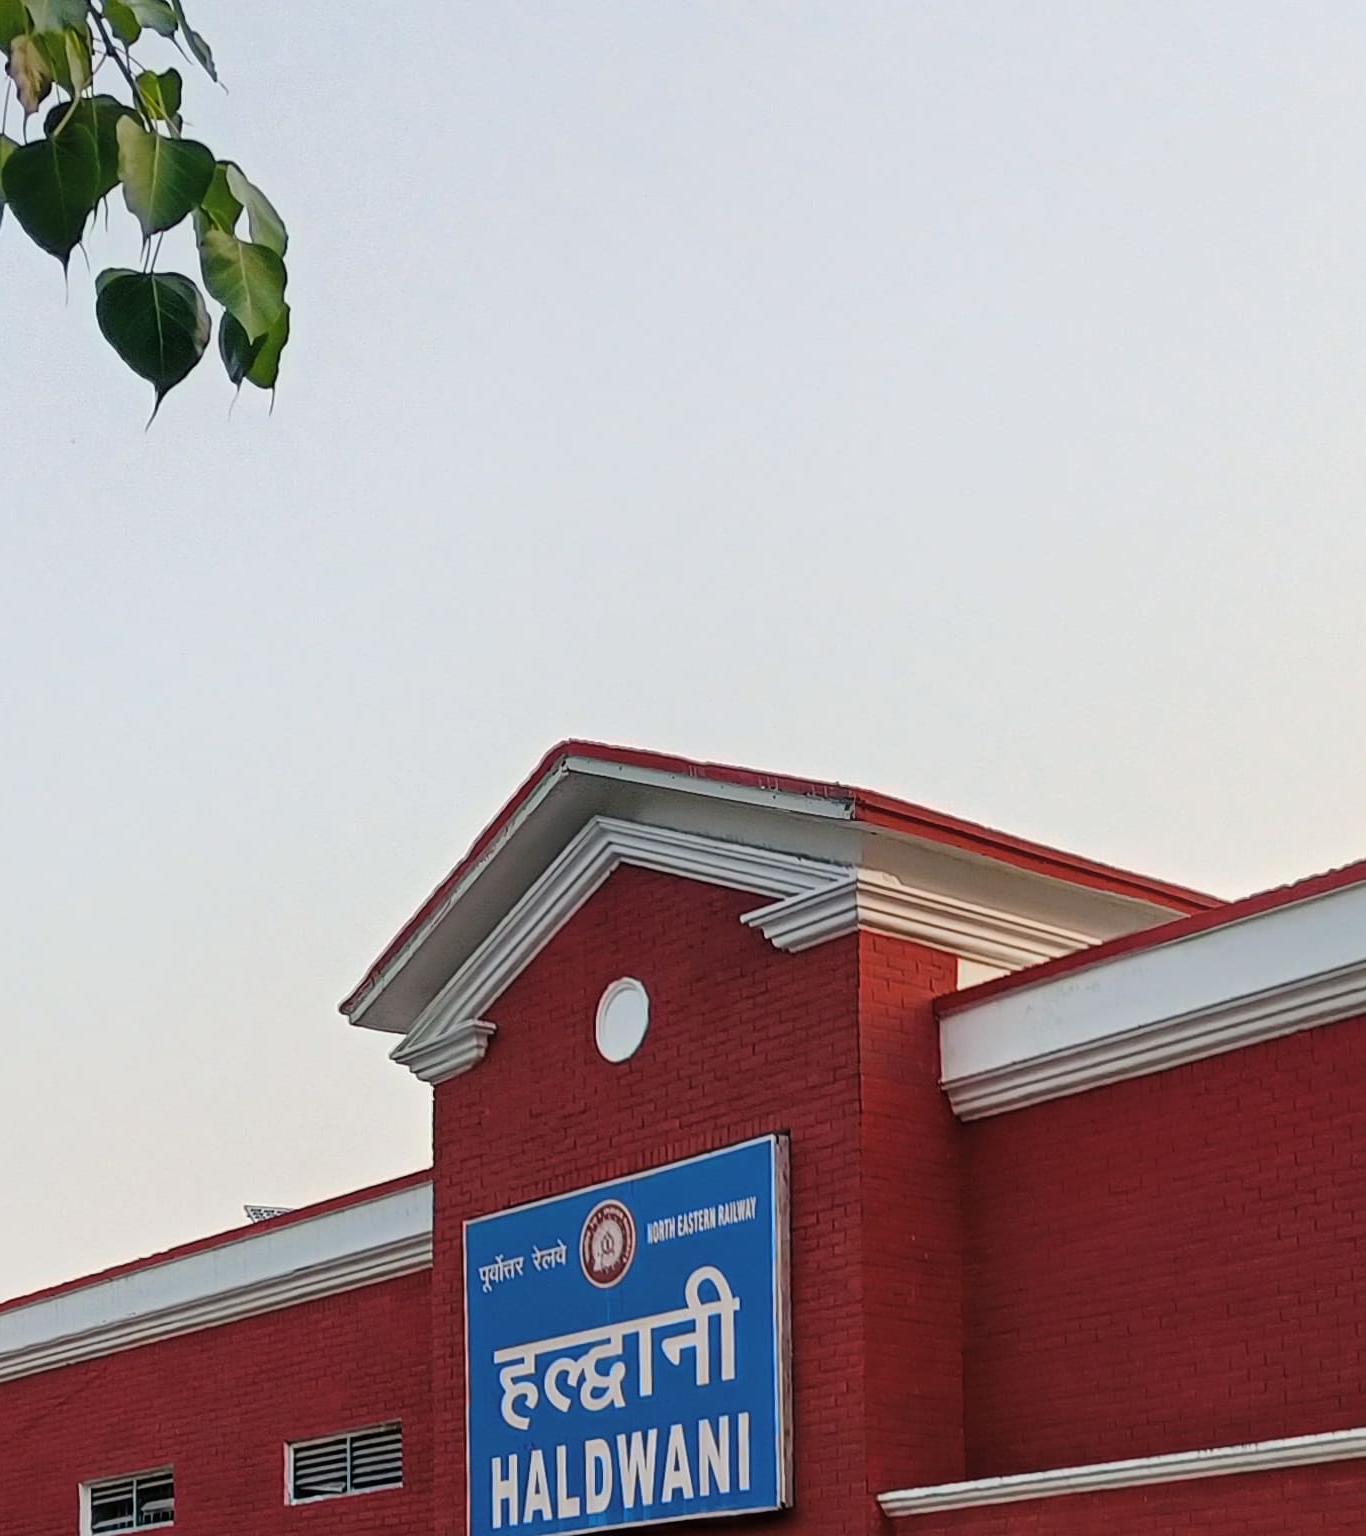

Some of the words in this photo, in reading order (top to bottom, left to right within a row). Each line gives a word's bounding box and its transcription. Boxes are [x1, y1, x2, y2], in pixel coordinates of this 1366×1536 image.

[647, 1214, 676, 1245] NORTH
[677, 1206, 717, 1237] EASTERN
[718, 1196, 757, 1227] RAILWAY
[478, 1253, 525, 1293] पूर्वोत्तर
[531, 1239, 567, 1271] रेलवे
[493, 1265, 740, 1431] हल्द्वानी
[491, 1411, 750, 1529] HALDWANI
